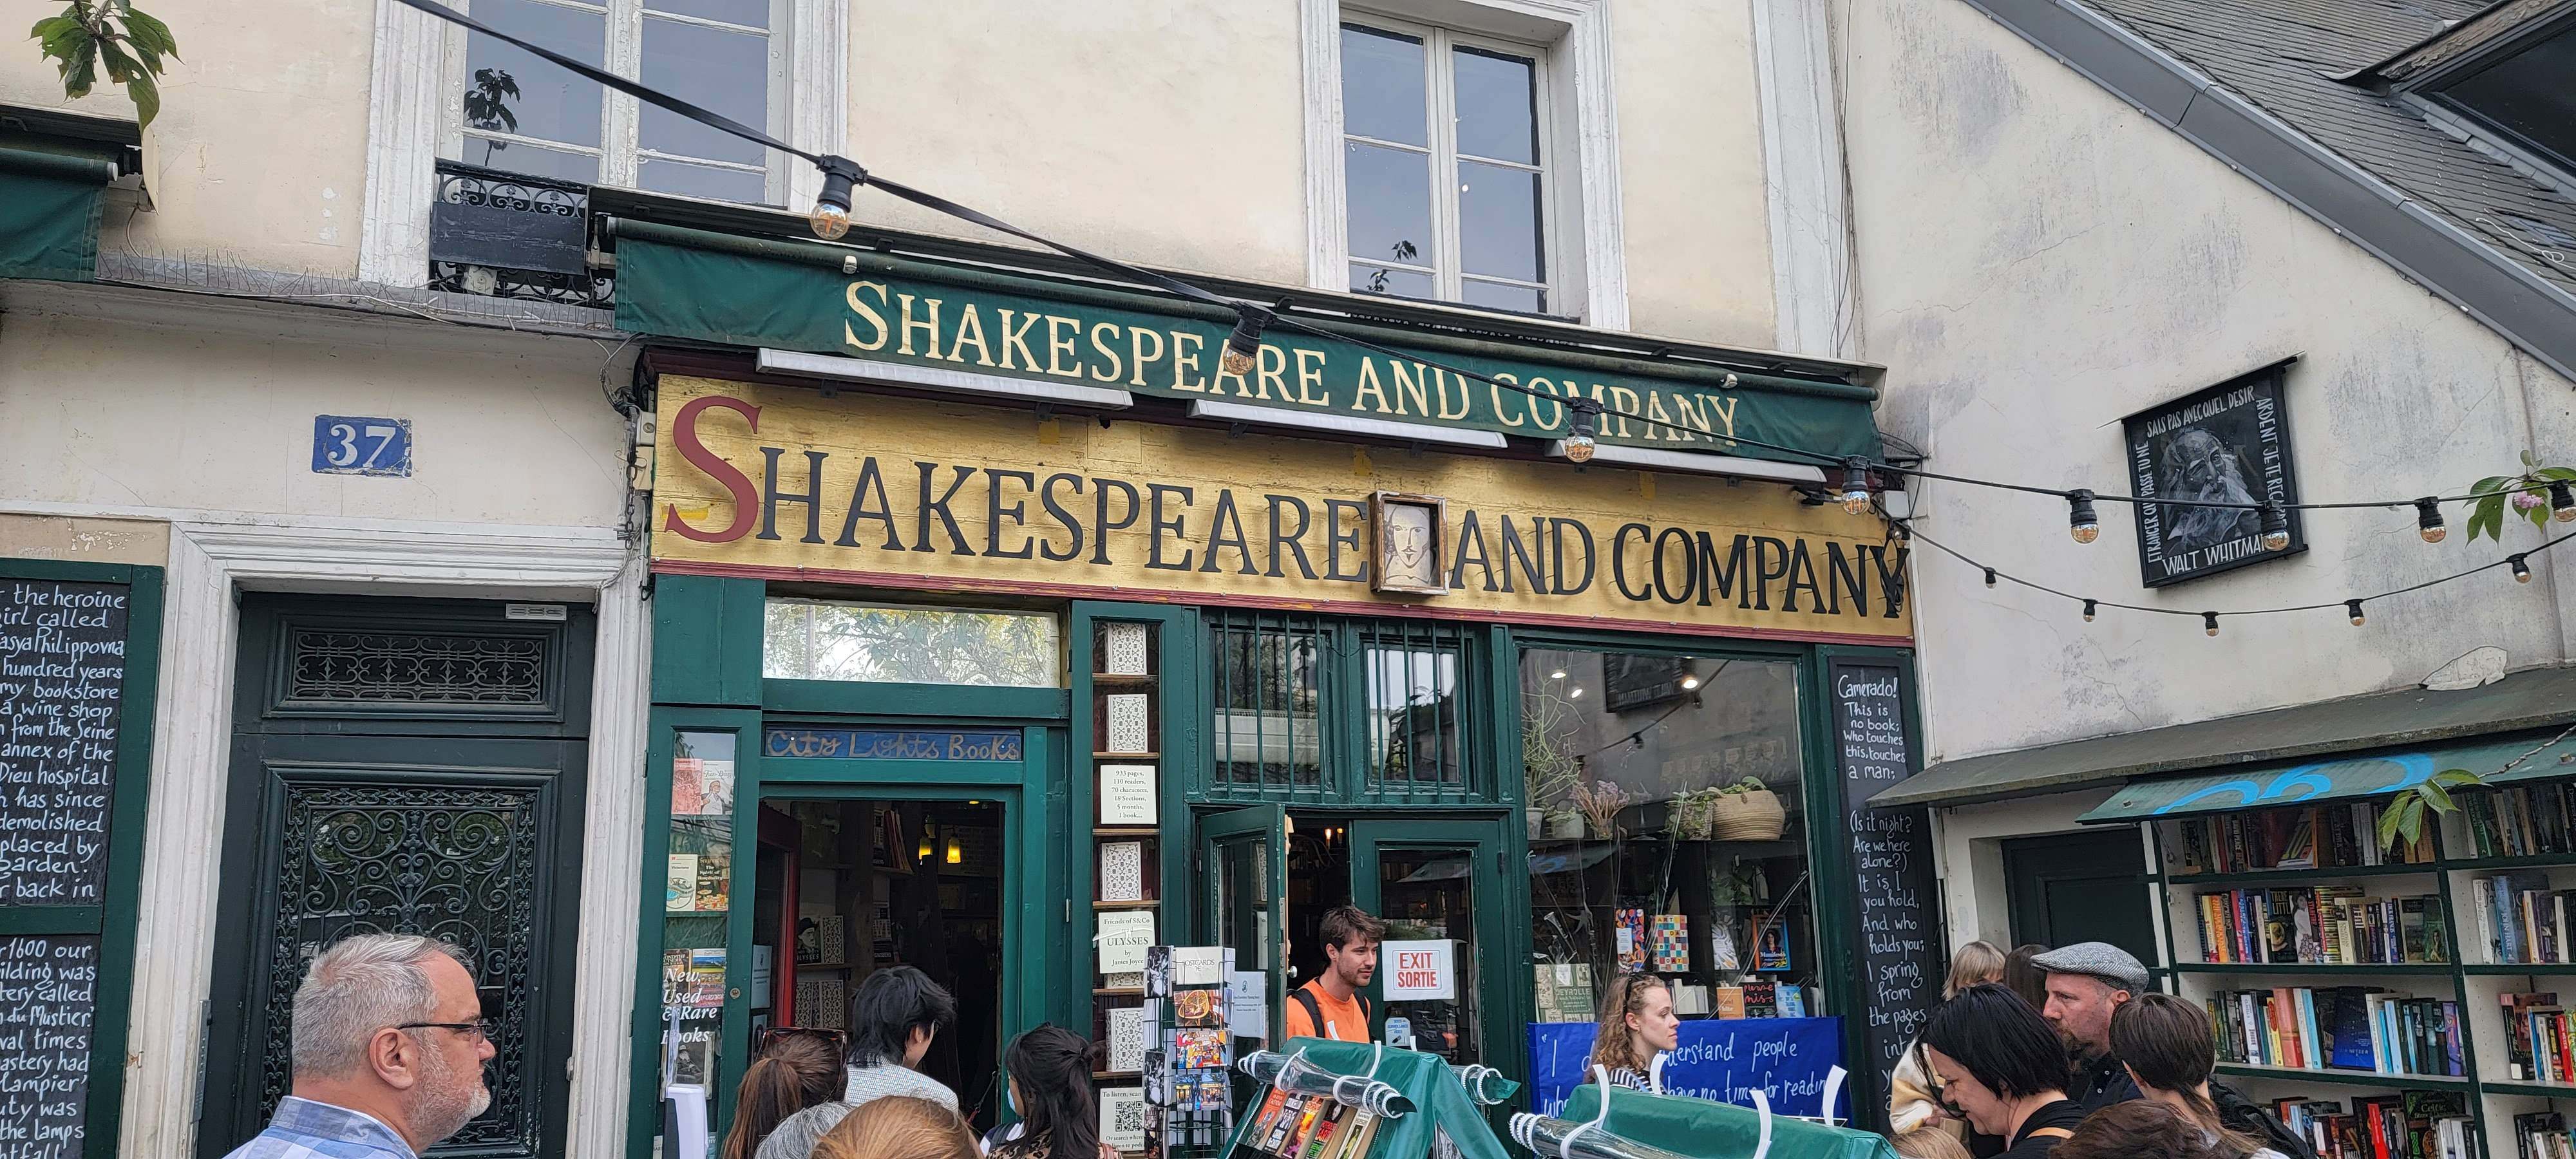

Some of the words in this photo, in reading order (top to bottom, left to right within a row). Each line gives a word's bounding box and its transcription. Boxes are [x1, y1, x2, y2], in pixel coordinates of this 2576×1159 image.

[845, 281, 1329, 407] SHAKESPEARE
[1351, 356, 1470, 420] AND
[1491, 373, 1737, 447] COMPANY
[2146, 417, 2166, 438] SAIS
[2167, 410, 2182, 431] PAS
[2183, 403, 2202, 426] AVEC
[2203, 396, 2227, 417] QUEL
[2228, 386, 2255, 409] DESIR
[2255, 397, 2278, 444] ARDENT
[327, 424, 395, 467] 37
[2136, 440, 2150, 459] NE
[2263, 445, 2279, 464] JE
[2138, 459, 2152, 473] TU
[2265, 462, 2281, 478] TE
[2139, 471, 2155, 497] PASSE
[664, 395, 1368, 583] SHAKESPEARE
[1450, 509, 1596, 595] AND
[1613, 523, 1909, 618] COMPANY
[2162, 550, 2200, 576] WALT
[2204, 533, 2266, 565] WHITMA
[14, 583, 49, 606] the
[53, 583, 126, 609] heroine
[0, 605, 32, 628] irl
[37, 609, 109, 628] called
[3, 657, 77, 678] hundred
[80, 667, 123, 686] years
[0, 682, 26, 701] my
[33, 679, 119, 700] bookstore
[1838, 675, 1898, 698] Camerado!
[22, 700, 64, 715] wine
[68, 701, 113, 727] shop
[1844, 701, 1872, 717] This
[1878, 702, 1888, 716] is
[11, 713, 43, 744] from
[48, 717, 71, 737] the
[73, 718, 115, 740] Seine
[1850, 719, 1864, 729] no
[1868, 718, 1899, 732] book;
[767, 731, 842, 757] City
[849, 732, 940, 759] Lights
[948, 734, 1020, 760] Books
[1843, 730, 1864, 741] Who
[1866, 731, 1903, 746] touches
[1, 742, 53, 759] annex
[57, 740, 80, 765] of
[83, 743, 113, 762] the
[1846, 744, 1868, 759] this,
[1869, 747, 1906, 763] touches
[37, 760, 109, 790] hospital
[1848, 765, 1859, 780] a
[1864, 766, 1895, 780] man;
[15, 786, 46, 808] has
[54, 790, 105, 807] since
[1850, 810, 1863, 833] (Is
[1867, 811, 1876, 832] it
[1879, 815, 1912, 838] night?
[77, 835, 100, 863] by
[1853, 836, 1871, 853] Are
[1873, 842, 1887, 852] we
[1887, 838, 1911, 853] here
[1861, 853, 1907, 873] alone?)
[16, 876, 65, 898] back
[72, 878, 95, 898] in
[1858, 873, 1870, 892] It
[1877, 874, 1889, 890] is
[1896, 871, 1901, 891] I
[1862, 896, 1885, 914] you
[1887, 889, 1919, 909] hold,
[1862, 914, 1889, 932] And
[1895, 911, 1917, 930] who
[9, 938, 46, 959] 1600
[55, 945, 91, 958] our
[1107, 937, 1148, 946] ULYSSES
[1868, 934, 1900, 955] holds
[1902, 939, 1925, 961] you;
[1399, 953, 1433, 968] EXIT
[0, 961, 54, 990] ilding
[59, 966, 96, 981] was
[664, 968, 701, 985] New,
[1398, 972, 1437, 988] SORTIE
[1867, 961, 1873, 983] I
[1880, 961, 1923, 988] spring
[0, 981, 34, 1011] tery
[38, 983, 92, 1002] called
[663, 988, 703, 1004] Used
[1877, 981, 1911, 1008] from
[7, 1007, 26, 1023] du
[680, 1006, 717, 1020] Rare
[1869, 1006, 1889, 1026] the
[1893, 1008, 1926, 1034] pages
[0, 1030, 24, 1050] val
[34, 1028, 86, 1050] times
[1665, 1032, 1734, 1067] derstand
[1751, 1031, 1797, 1073] people
[0, 1051, 53, 1079] astery
[57, 1051, 90, 1072] had
[1701, 1088, 1717, 1101] no
[1763, 1071, 1779, 1100] for
[1784, 1071, 1826, 1104] readin
[40, 1102, 77, 1117] was
[0, 1118, 28, 1140] the
[35, 1118, 85, 1149] lamps
